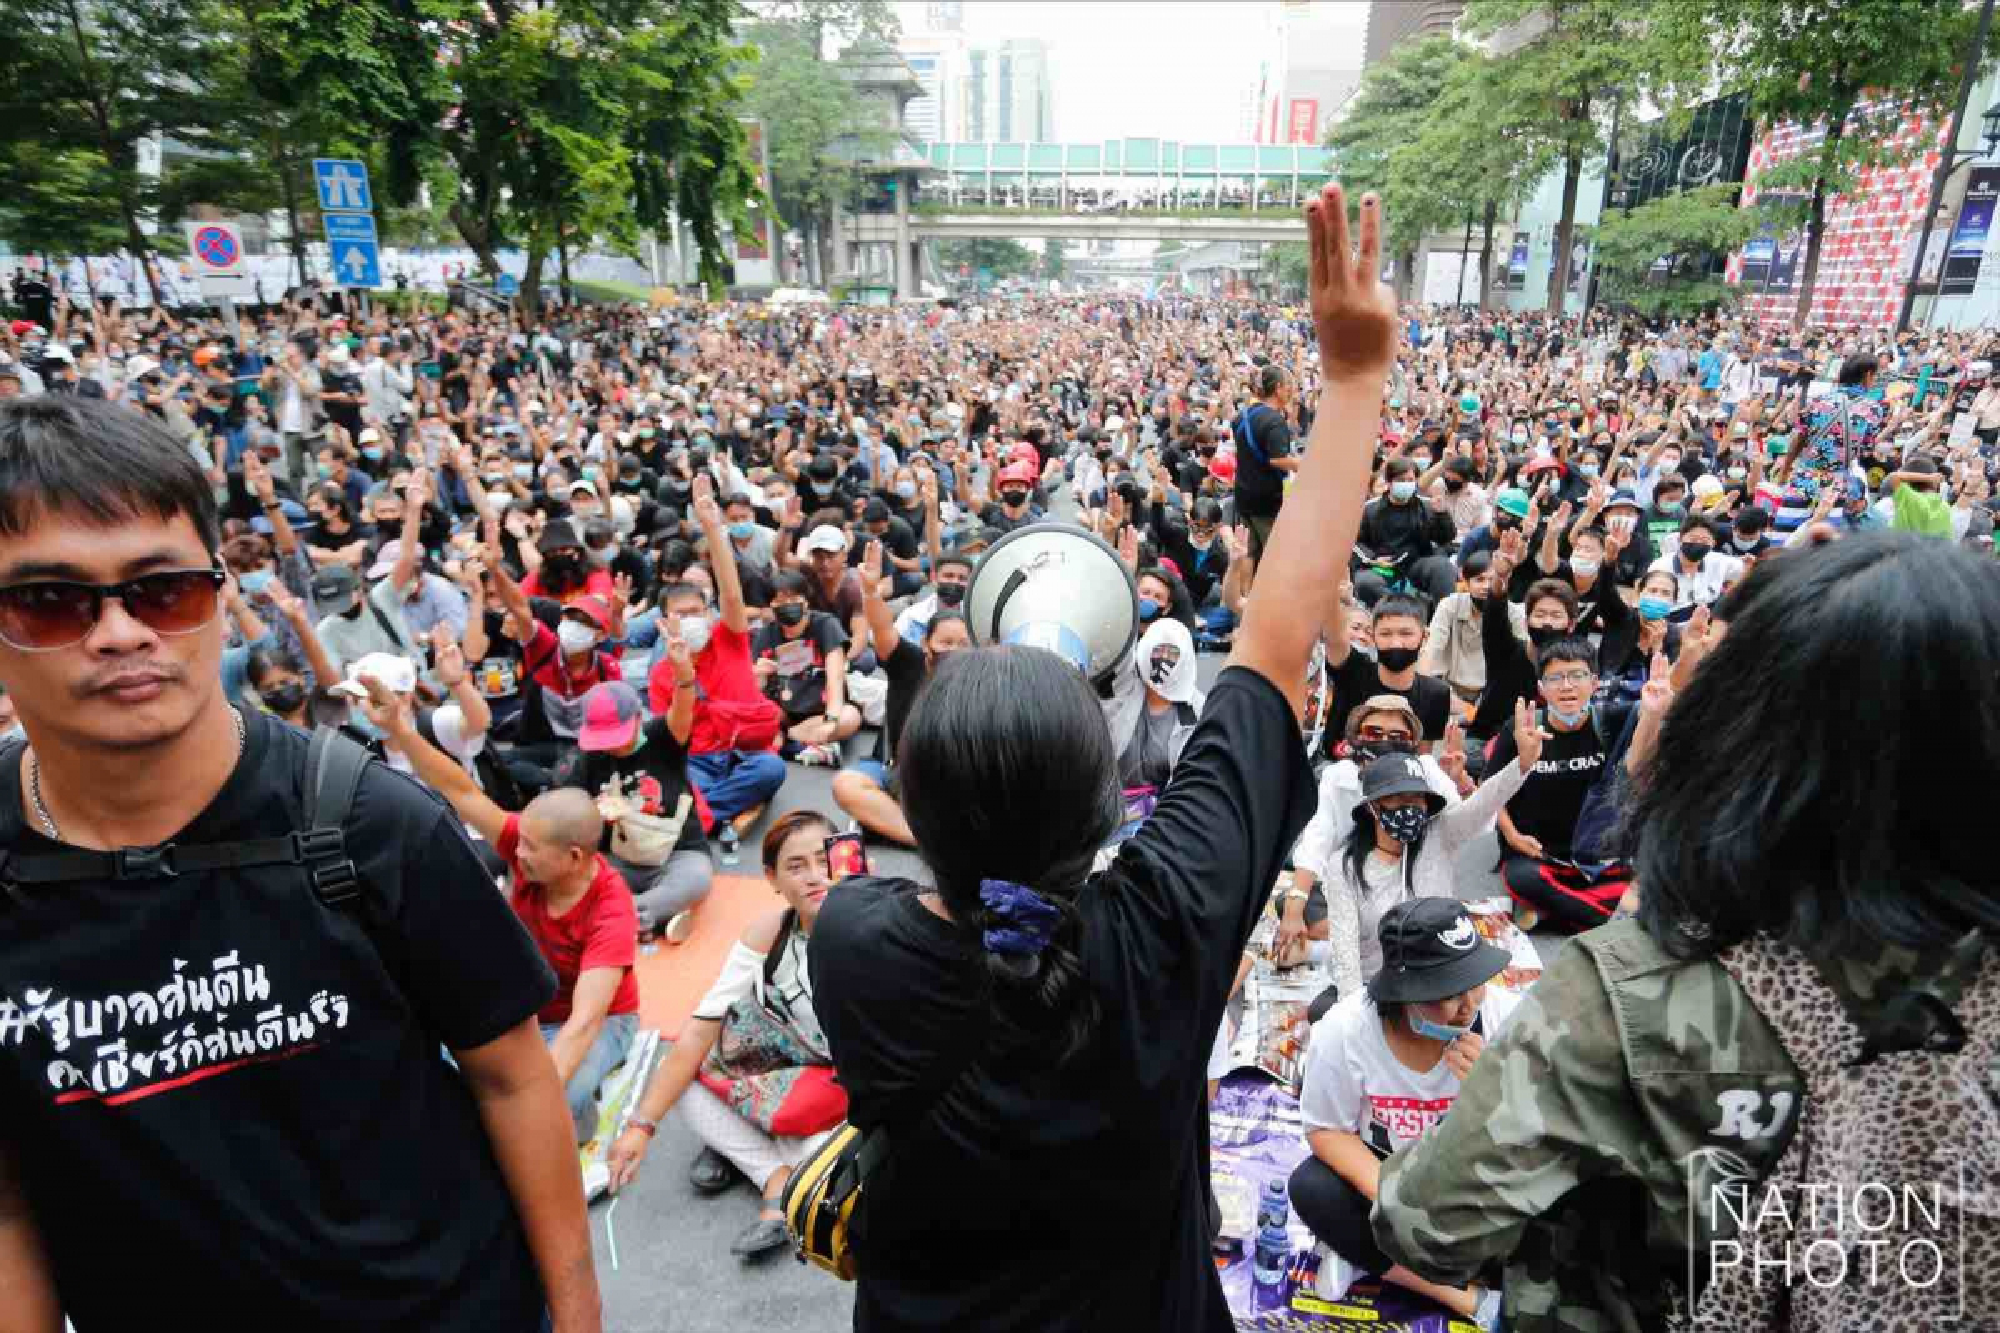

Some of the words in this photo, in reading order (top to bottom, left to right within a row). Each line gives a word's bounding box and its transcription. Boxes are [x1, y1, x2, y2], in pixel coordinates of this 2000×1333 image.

[47, 1004, 316, 1093] คเชียร์ก็ส้นตีน
[1708, 1089, 1794, 1140] RJ
